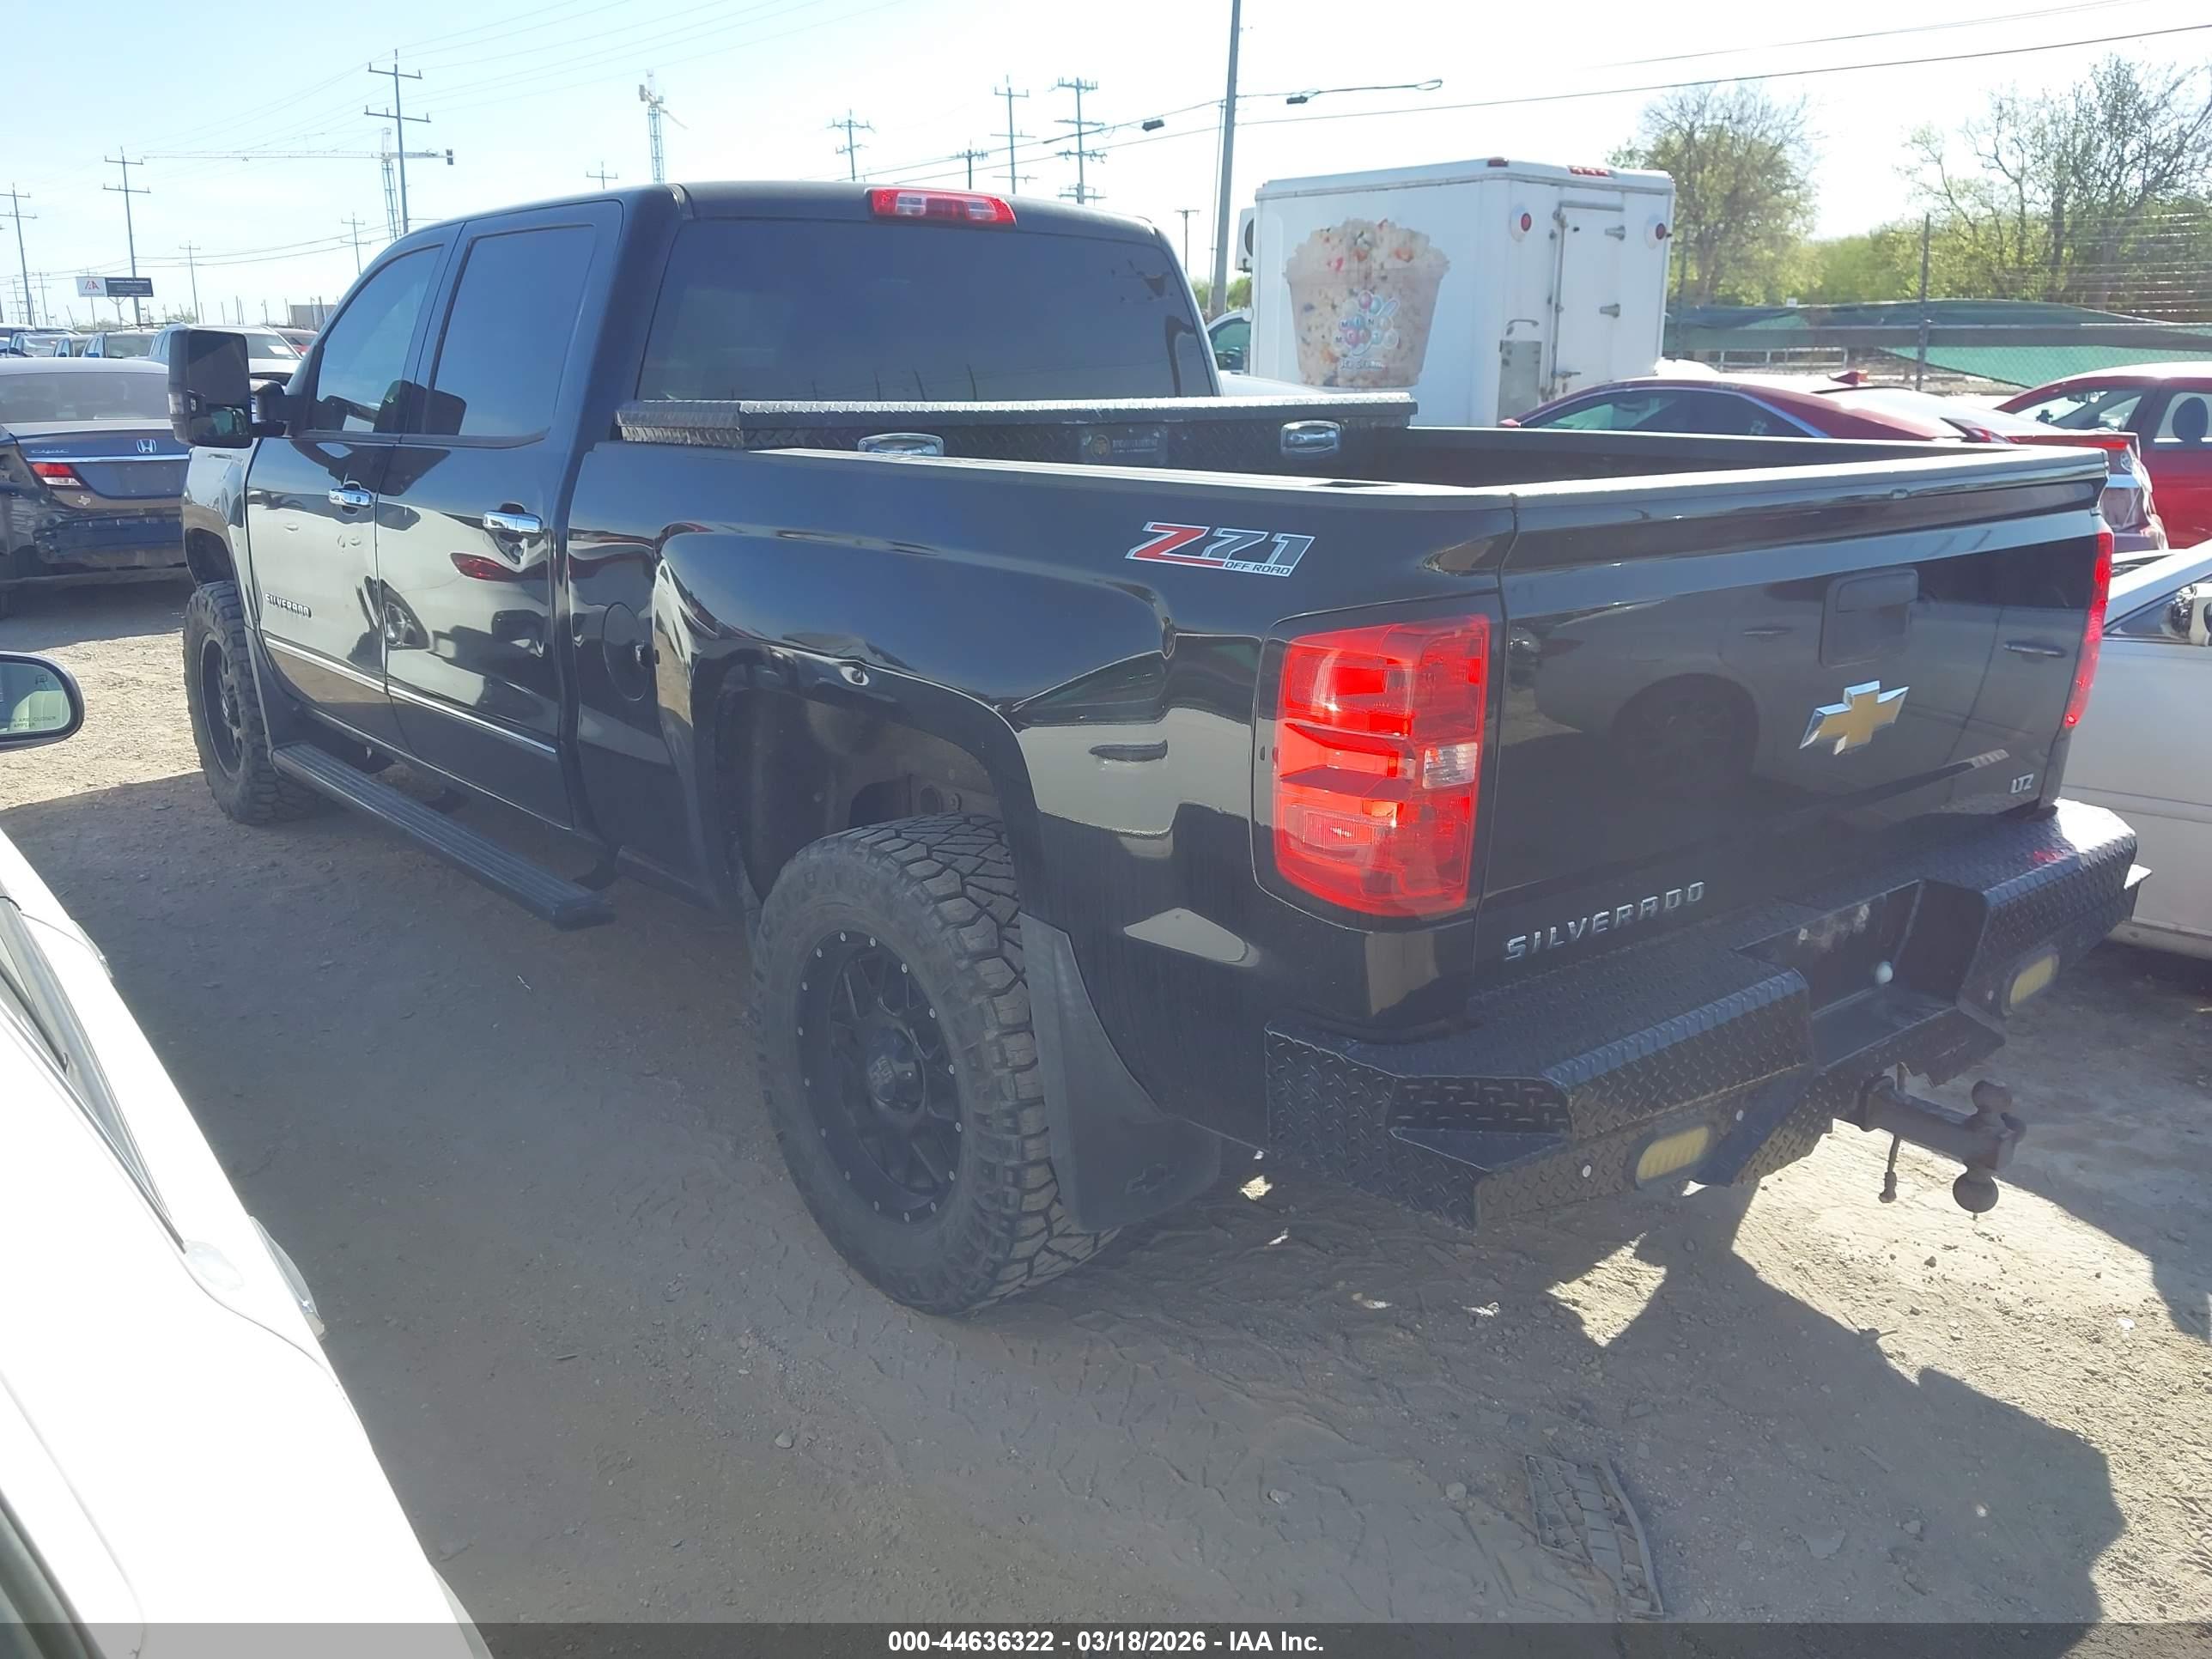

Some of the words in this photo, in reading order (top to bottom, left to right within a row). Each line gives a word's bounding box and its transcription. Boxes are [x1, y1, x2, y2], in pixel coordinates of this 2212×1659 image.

[1125, 521, 1316, 568] Z71
[1224, 561, 1252, 571] OFF
[1252, 564, 1291, 575] ROAD
[2010, 773, 2034, 793] LTZ
[1504, 881, 1705, 961] SILVERADO
